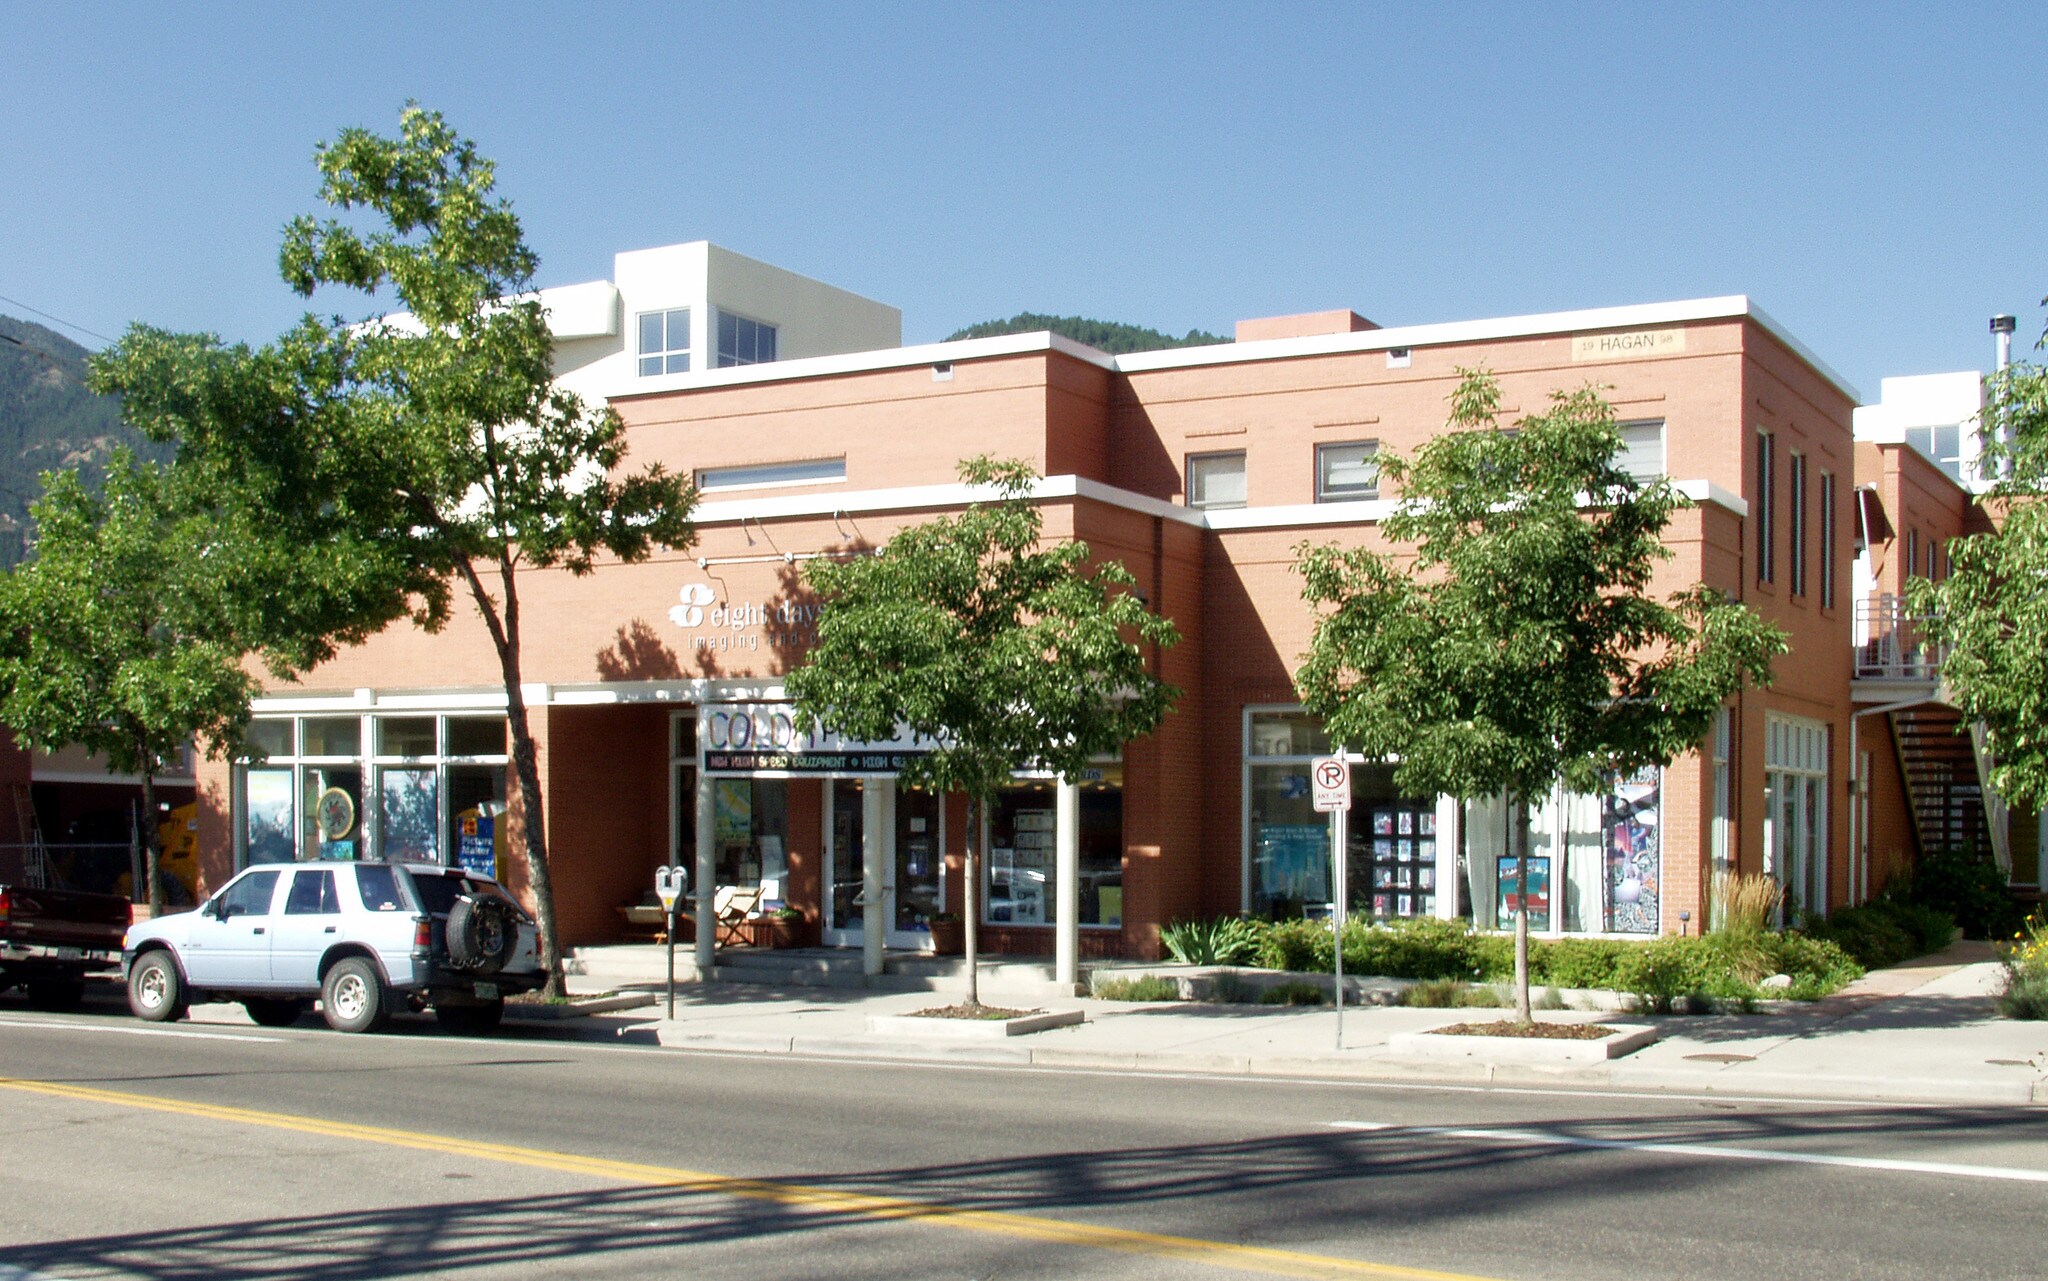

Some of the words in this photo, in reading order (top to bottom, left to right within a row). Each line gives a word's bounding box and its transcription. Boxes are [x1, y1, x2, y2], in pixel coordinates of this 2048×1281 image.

[1600, 334, 1655, 352] HAGAN
[710, 601, 768, 632] eight
[775, 599, 826, 628] days
[687, 632, 759, 652] imaging
[769, 631, 798, 647] and
[758, 755, 788, 768] SPEED
[792, 756, 847, 768] EQUIPMENT
[862, 756, 888, 769] HIGH
[1325, 766, 1341, 785] P
